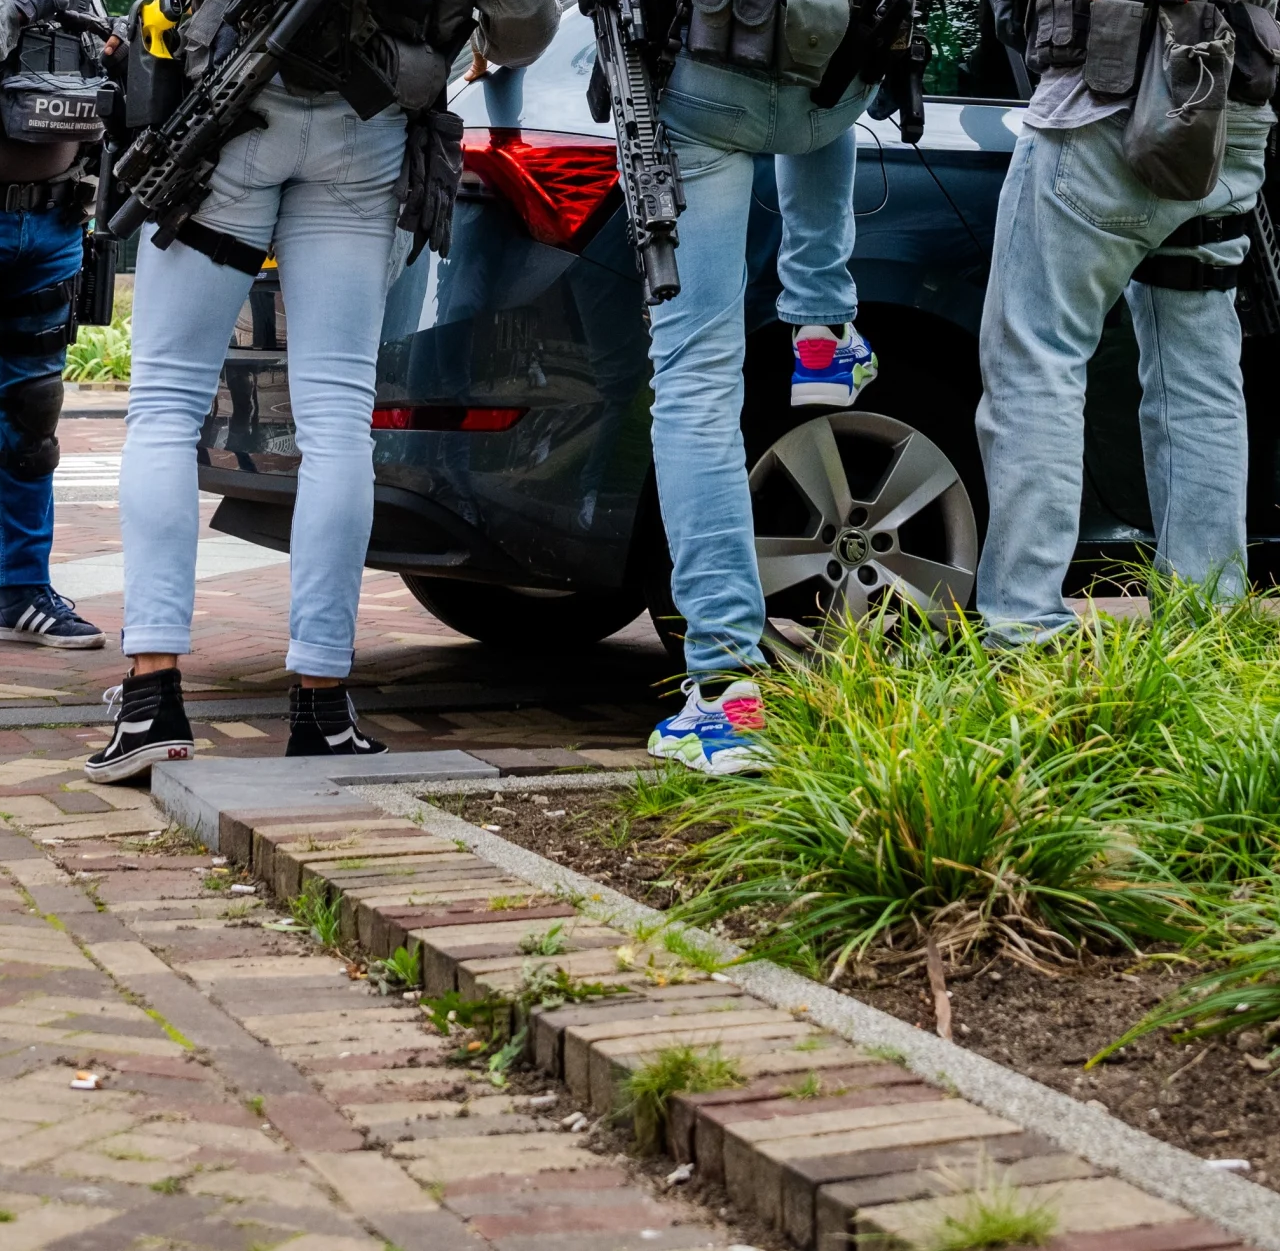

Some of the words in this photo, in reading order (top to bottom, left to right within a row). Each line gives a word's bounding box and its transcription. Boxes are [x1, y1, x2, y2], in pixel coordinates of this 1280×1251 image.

[35, 98, 98, 118] POLITI
[29, 119, 49, 128] DIENST
[50, 121, 74, 130] SPECIALE
